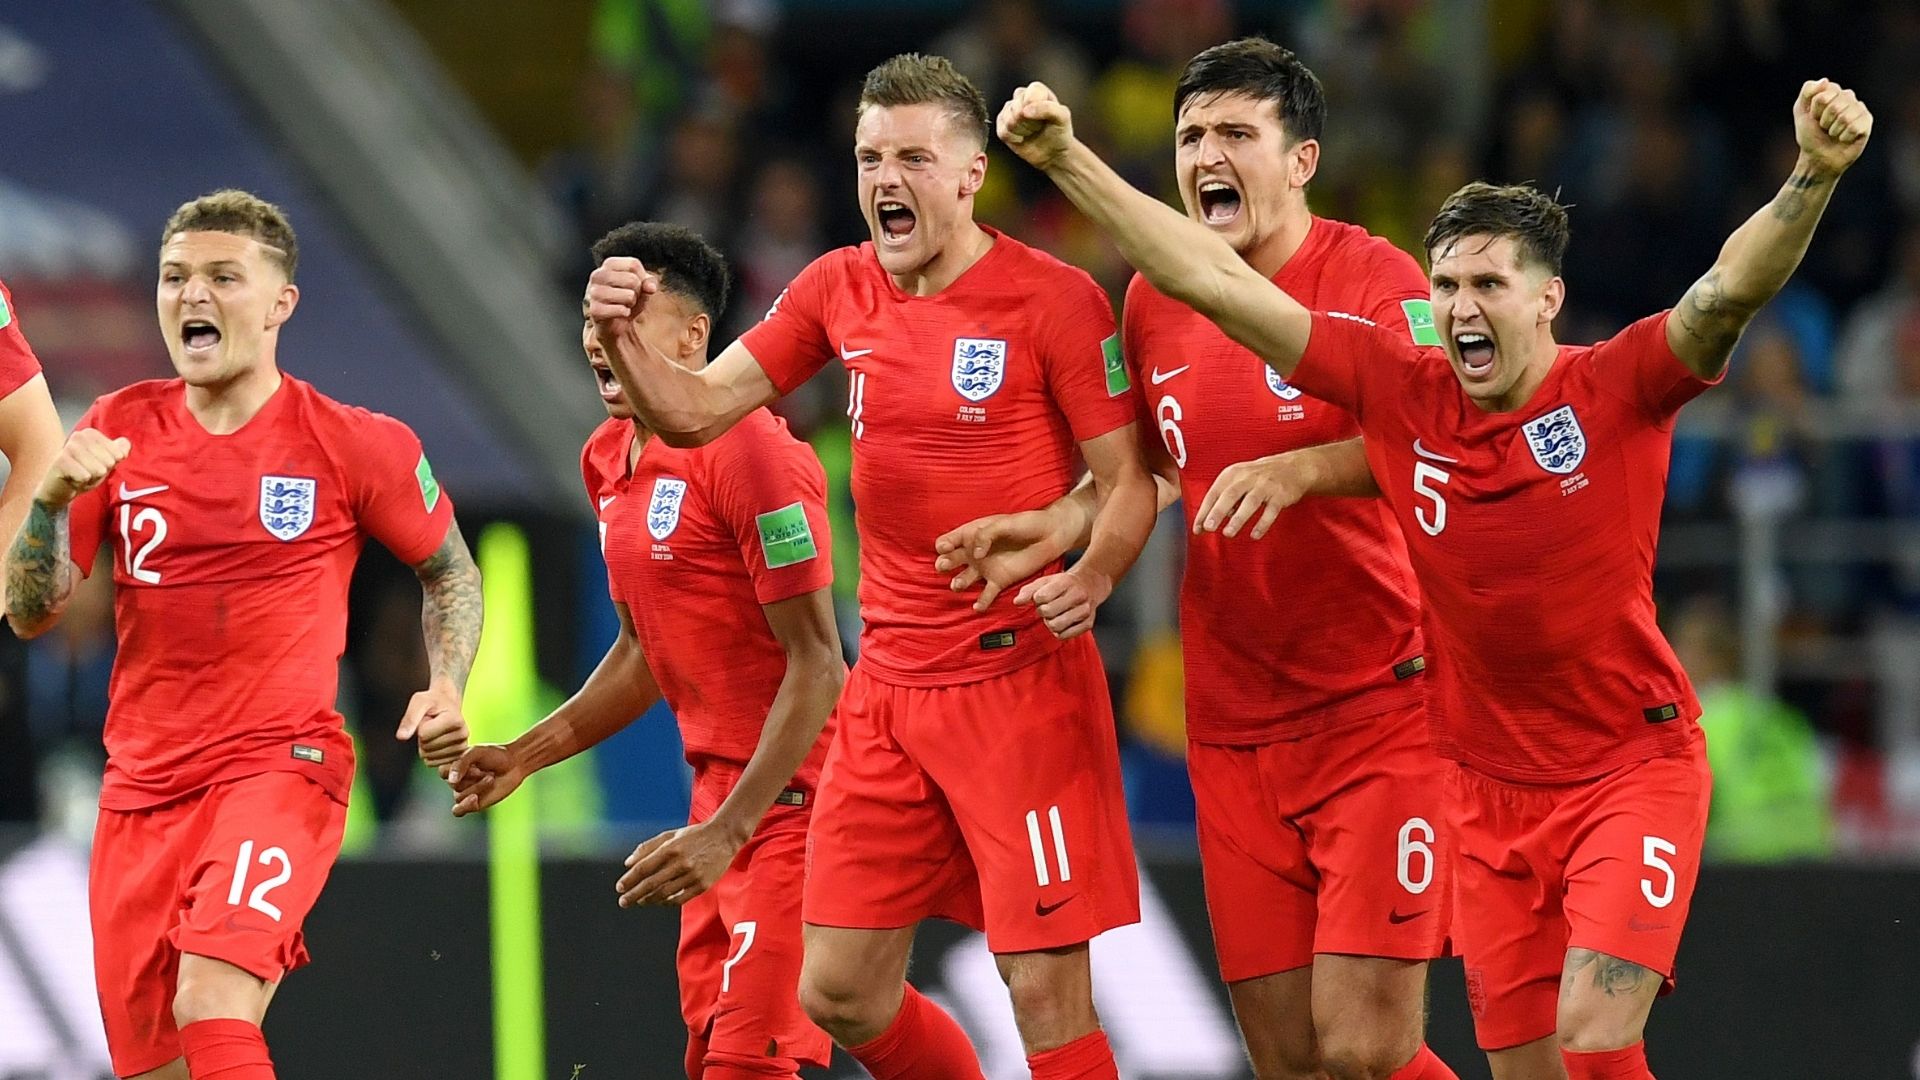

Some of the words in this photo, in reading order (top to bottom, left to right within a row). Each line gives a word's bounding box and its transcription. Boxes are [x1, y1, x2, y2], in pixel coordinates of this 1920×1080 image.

[846, 370, 865, 440] 11
[1157, 395, 1187, 469] 6
[1413, 462, 1449, 536] 5
[119, 504, 168, 585] 12
[227, 839, 292, 922] 12
[1025, 805, 1071, 887] 11
[1397, 817, 1435, 894] 6
[1640, 836, 1677, 908] 5
[722, 921, 757, 993] 7
